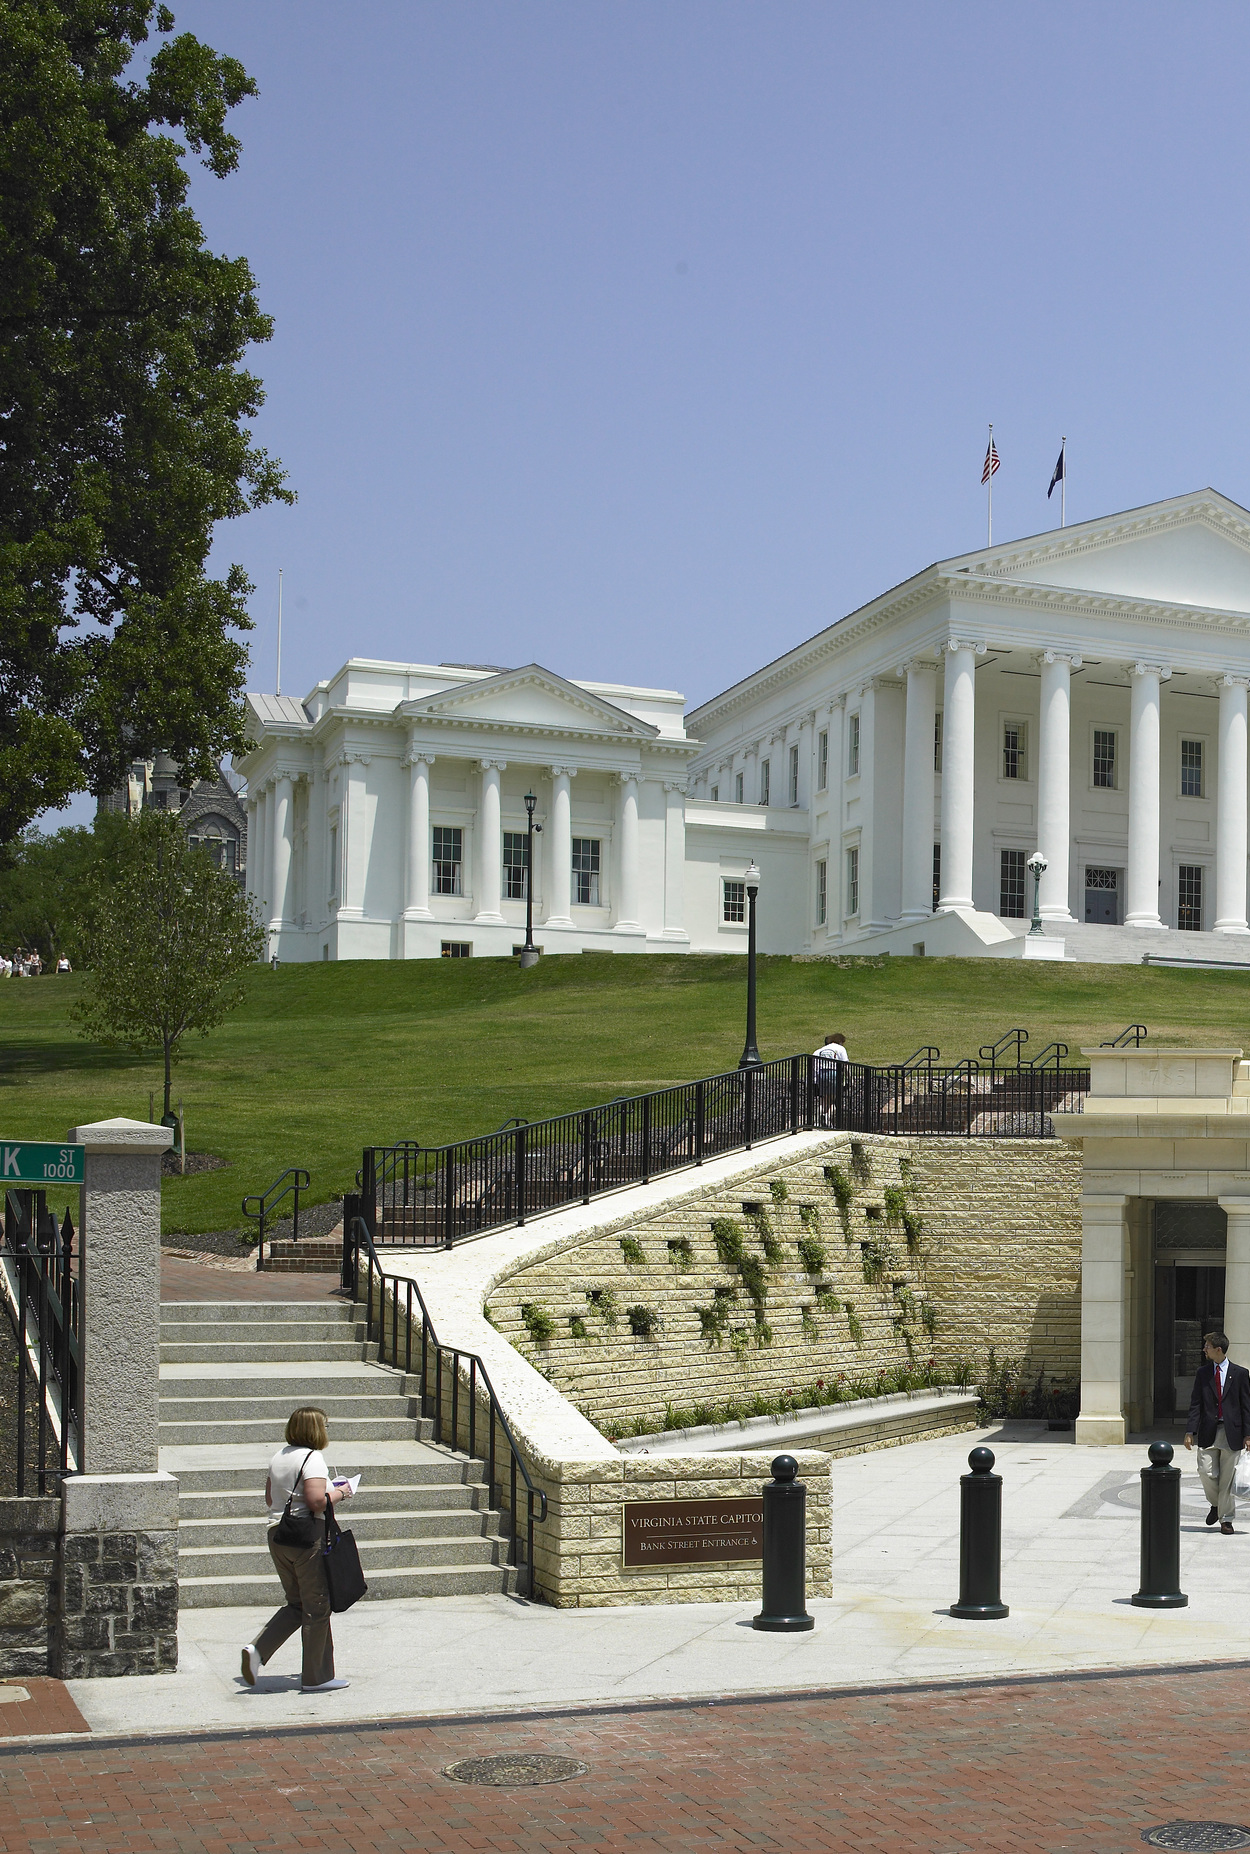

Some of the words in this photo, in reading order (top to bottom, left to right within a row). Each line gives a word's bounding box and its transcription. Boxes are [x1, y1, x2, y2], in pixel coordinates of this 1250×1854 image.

[0, 1147, 21, 1176] K
[60, 1149, 75, 1163] ST
[43, 1163, 75, 1178] 1000
[631, 1517, 683, 1528] VIRGINIA
[685, 1515, 718, 1526] STATE
[640, 1542, 666, 1551] BANK
[667, 1540, 699, 1550] STREET
[702, 1538, 749, 1548] ENTRANCE
